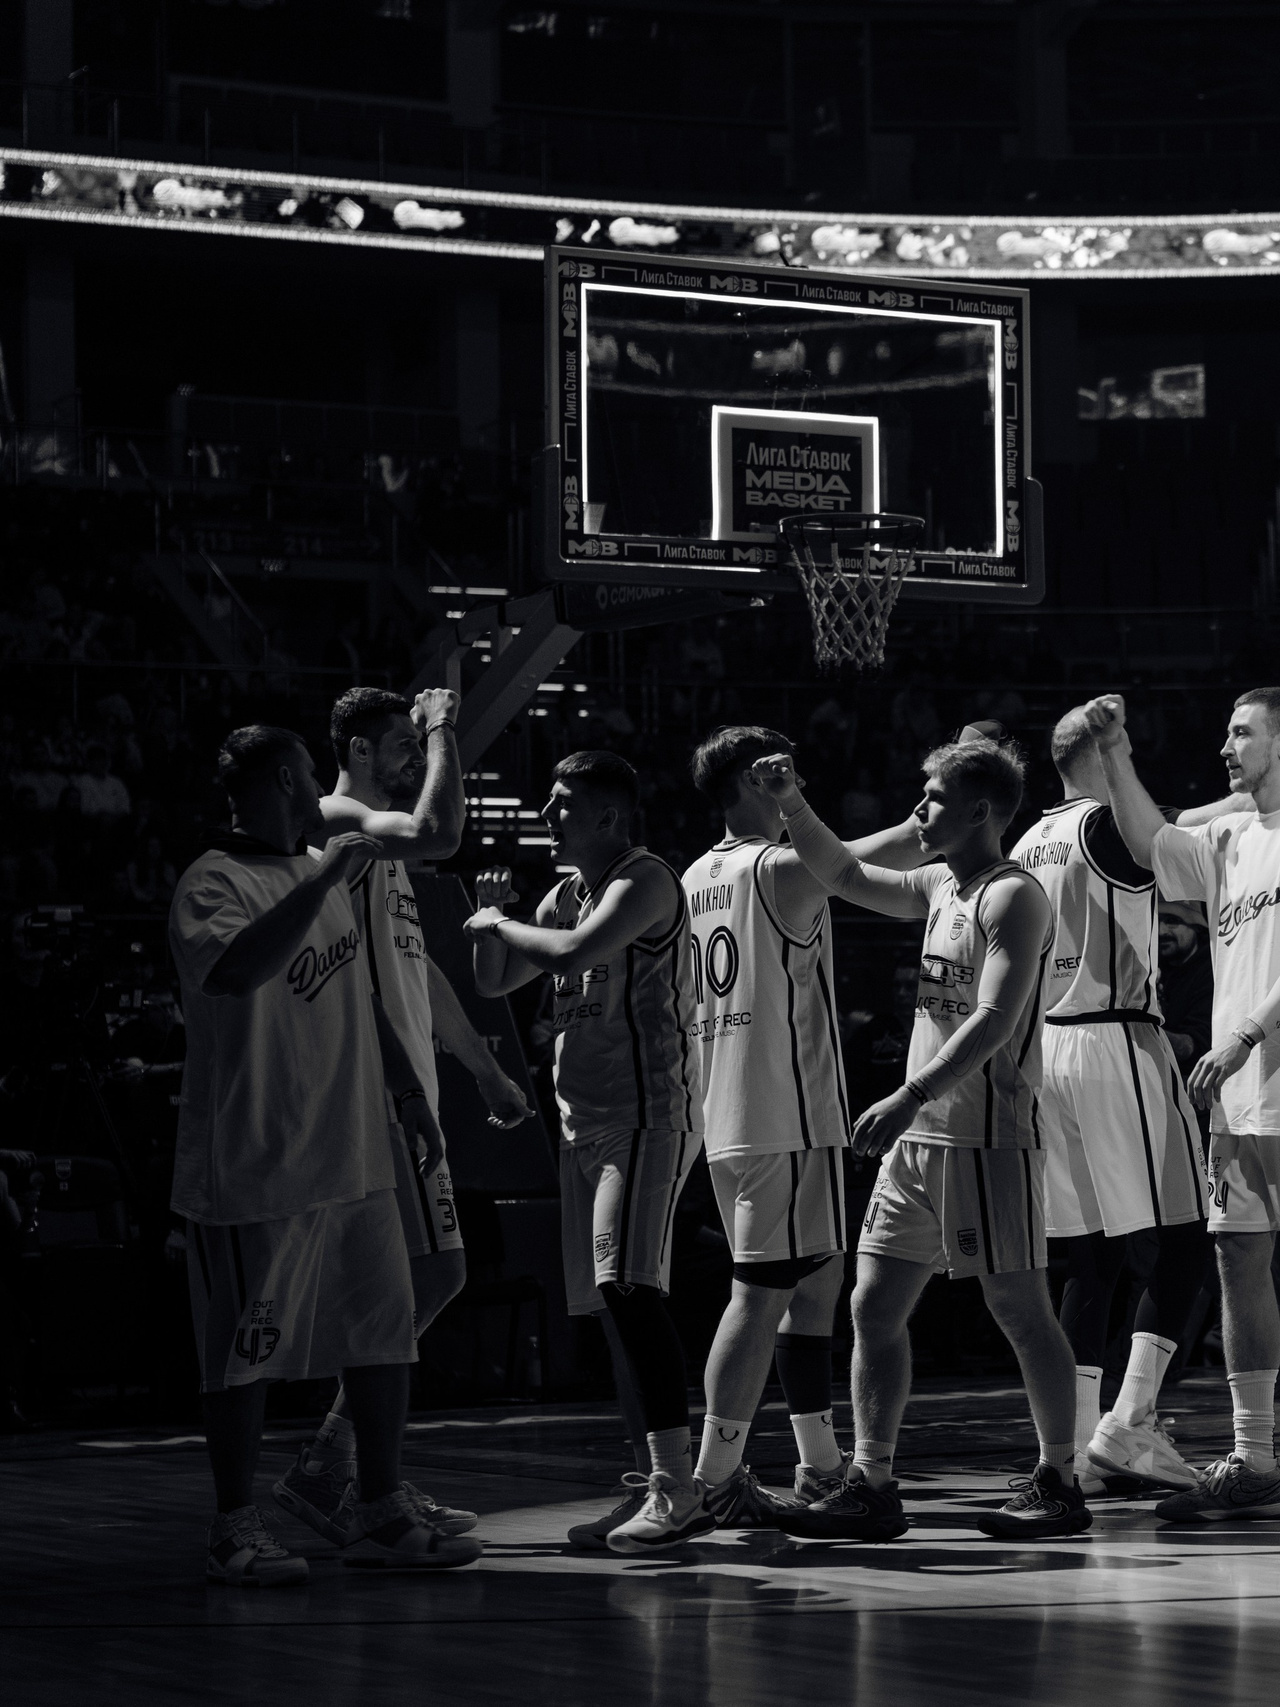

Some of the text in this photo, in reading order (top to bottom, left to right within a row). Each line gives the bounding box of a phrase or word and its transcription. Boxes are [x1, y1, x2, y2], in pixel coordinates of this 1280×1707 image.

[641, 269, 703, 288] ЛИГА СТАВОК
[802, 286, 862, 303] ЛИГА СТАВОК
[956, 299, 1015, 317] ЛИГА СТАВОК
[747, 441, 852, 472] ЛИГА СТАВОК
[745, 469, 851, 495] MEDIA
[745, 490, 852, 511] BASKET
[663, 543, 726, 561] ЛИГА СТАВОК
[958, 561, 1016, 578] ЛИГА СТАВОК
[691, 884, 733, 918] MIKHON
[287, 929, 360, 1003] Dawg
[691, 926, 739, 1005] 10
[723, 1012, 752, 1027] REC
[252, 1300, 274, 1309] OUT
[250, 1317, 273, 1325] REC
[235, 1327, 281, 1366] 43
